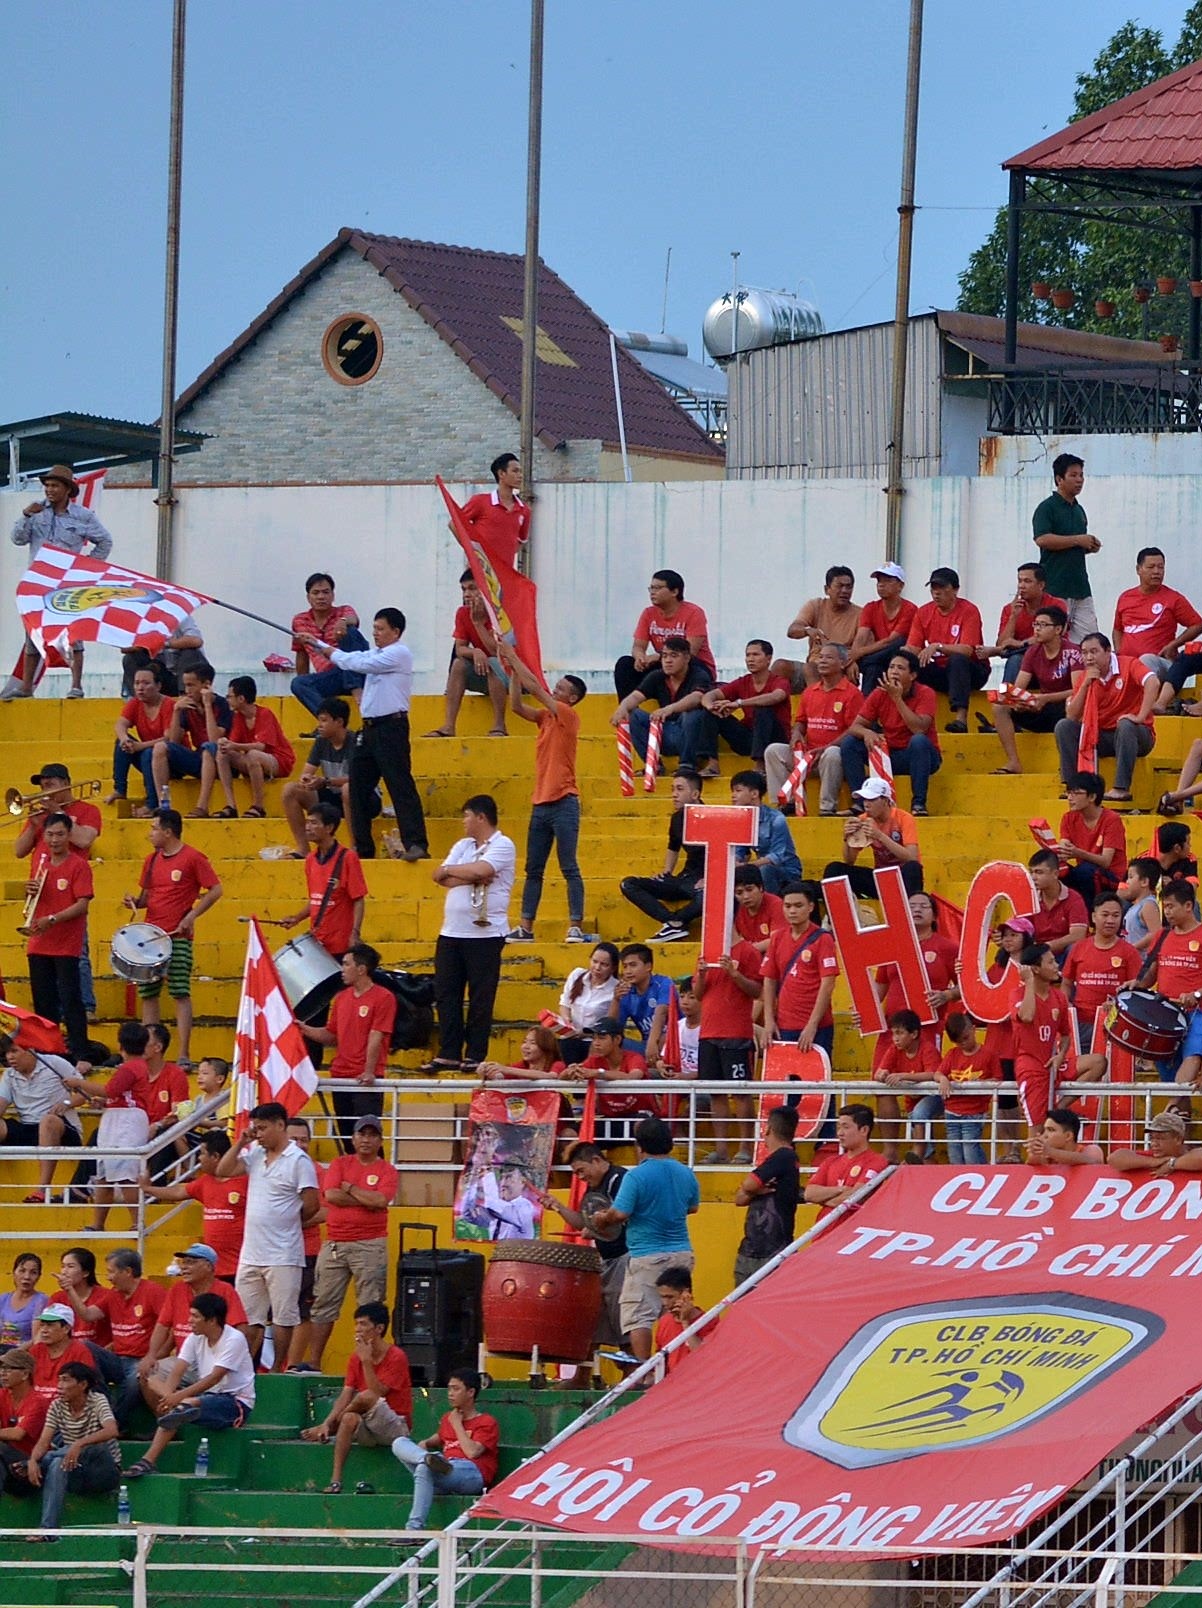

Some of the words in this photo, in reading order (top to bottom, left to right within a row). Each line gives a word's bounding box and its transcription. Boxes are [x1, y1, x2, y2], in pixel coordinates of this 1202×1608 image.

[683, 803, 760, 968] T
[821, 866, 939, 1037] H
[732, 1063, 745, 1079] 25
[930, 1172, 1064, 1219] CLB
[837, 1226, 1055, 1272] TP.HỒ
[1047, 1235, 1176, 1278] CHÍ
[889, 1341, 985, 1364] TP.HỒ
[980, 1346, 1034, 1366] CHÍ
[1030, 1350, 1100, 1371] MINH
[936, 1325, 990, 1343] CLB
[991, 1321, 1063, 1345] BÓNG
[1063, 1326, 1106, 1347] ĐÁ
[510, 1457, 653, 1523] HỘI
[638, 1470, 776, 1537] CỔ
[738, 1491, 922, 1556] ĐỘNG
[910, 1483, 1068, 1545] VIÊN
